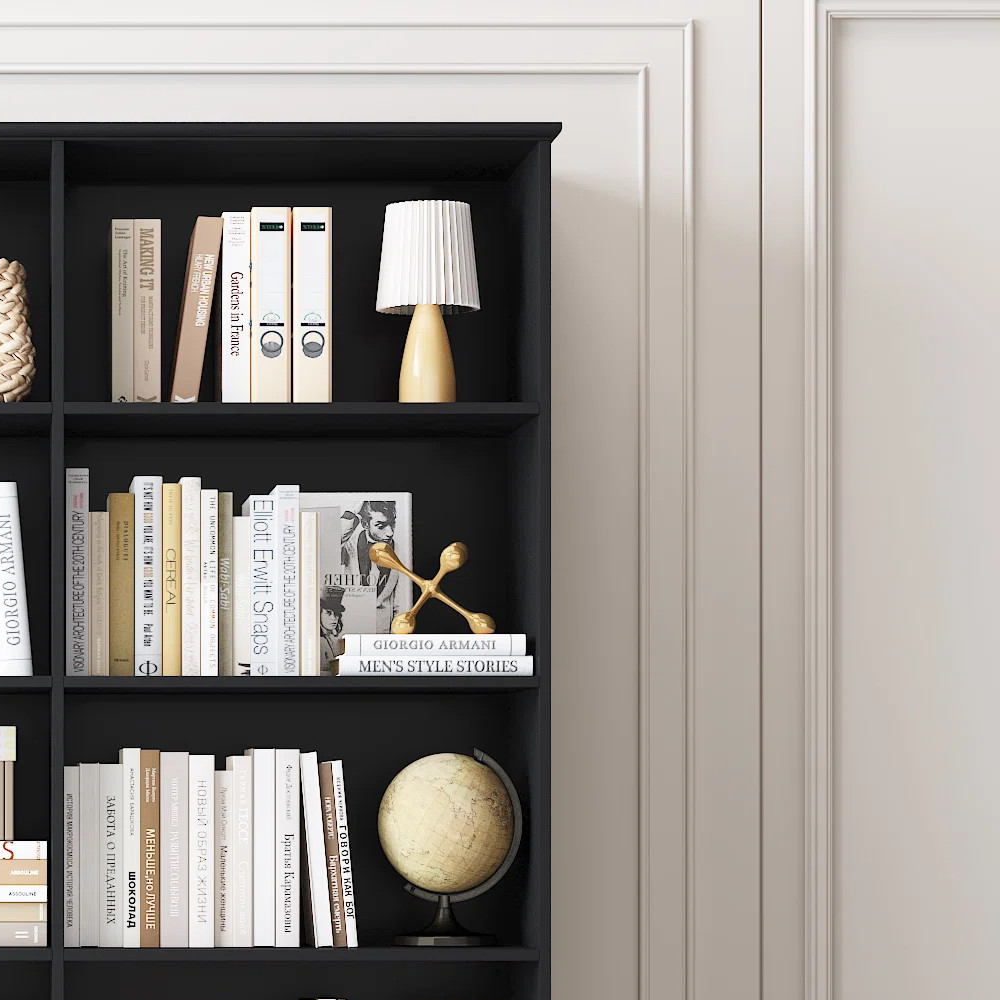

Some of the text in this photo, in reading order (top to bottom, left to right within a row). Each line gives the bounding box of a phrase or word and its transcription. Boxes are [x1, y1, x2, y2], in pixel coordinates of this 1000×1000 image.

[139, 228, 154, 290] MAKING IT
[195, 254, 215, 327] NEW URBAN HOUSING
[231, 271, 244, 357] Gardens in France
[143, 482, 154, 490] IT'S
[143, 492, 154, 500] NOT
[143, 502, 154, 511] HOW
[72, 510, 84, 545] CENTURY
[143, 525, 154, 534] YOU
[143, 536, 154, 544] ARE,
[283, 525, 295, 556] CENTURY
[72, 546, 84, 565] 20TH
[143, 546, 154, 554] IT'S
[143, 556, 154, 565] HOW
[72, 566, 84, 580] THE
[251, 500, 274, 655] Elliott Erwitt Snaps
[283, 556, 295, 574] 20TH
[72, 581, 84, 590] OF
[143, 580, 154, 588] YOU
[143, 590, 154, 600] WANT
[166, 548, 176, 614] CEREAL
[283, 576, 295, 587] THE
[283, 588, 295, 597] OF
[2, 581, 21, 646] GIORGIO
[72, 591, 84, 640] ARCHITECTURE
[143, 624, 154, 632] Paul
[283, 598, 295, 643] ARCHITECTURE
[143, 634, 154, 647] Arden
[373, 640, 496, 650] GIORGIO ARMANI
[72, 641, 84, 673] VISIONARY
[283, 643, 295, 673] VISIONARY
[359, 660, 518, 673] MEN'S STYLE STORIES
[106, 796, 116, 924] ЗАБОТА О ПРЕДАННЫХ
[197, 780, 208, 923] НОВЫЙ ОБРАЗ ЖИЗНИ
[281, 833, 294, 933] Братья Карамазовы
[339, 825, 354, 919] ГОВОРИ КАК БОГ
[127, 872, 136, 928] ШОКОЛАД
[219, 845, 228, 932] Маленькие женщины
[144, 892, 156, 930] ЛУЧШЕ
[333, 904, 342, 933] смерть
